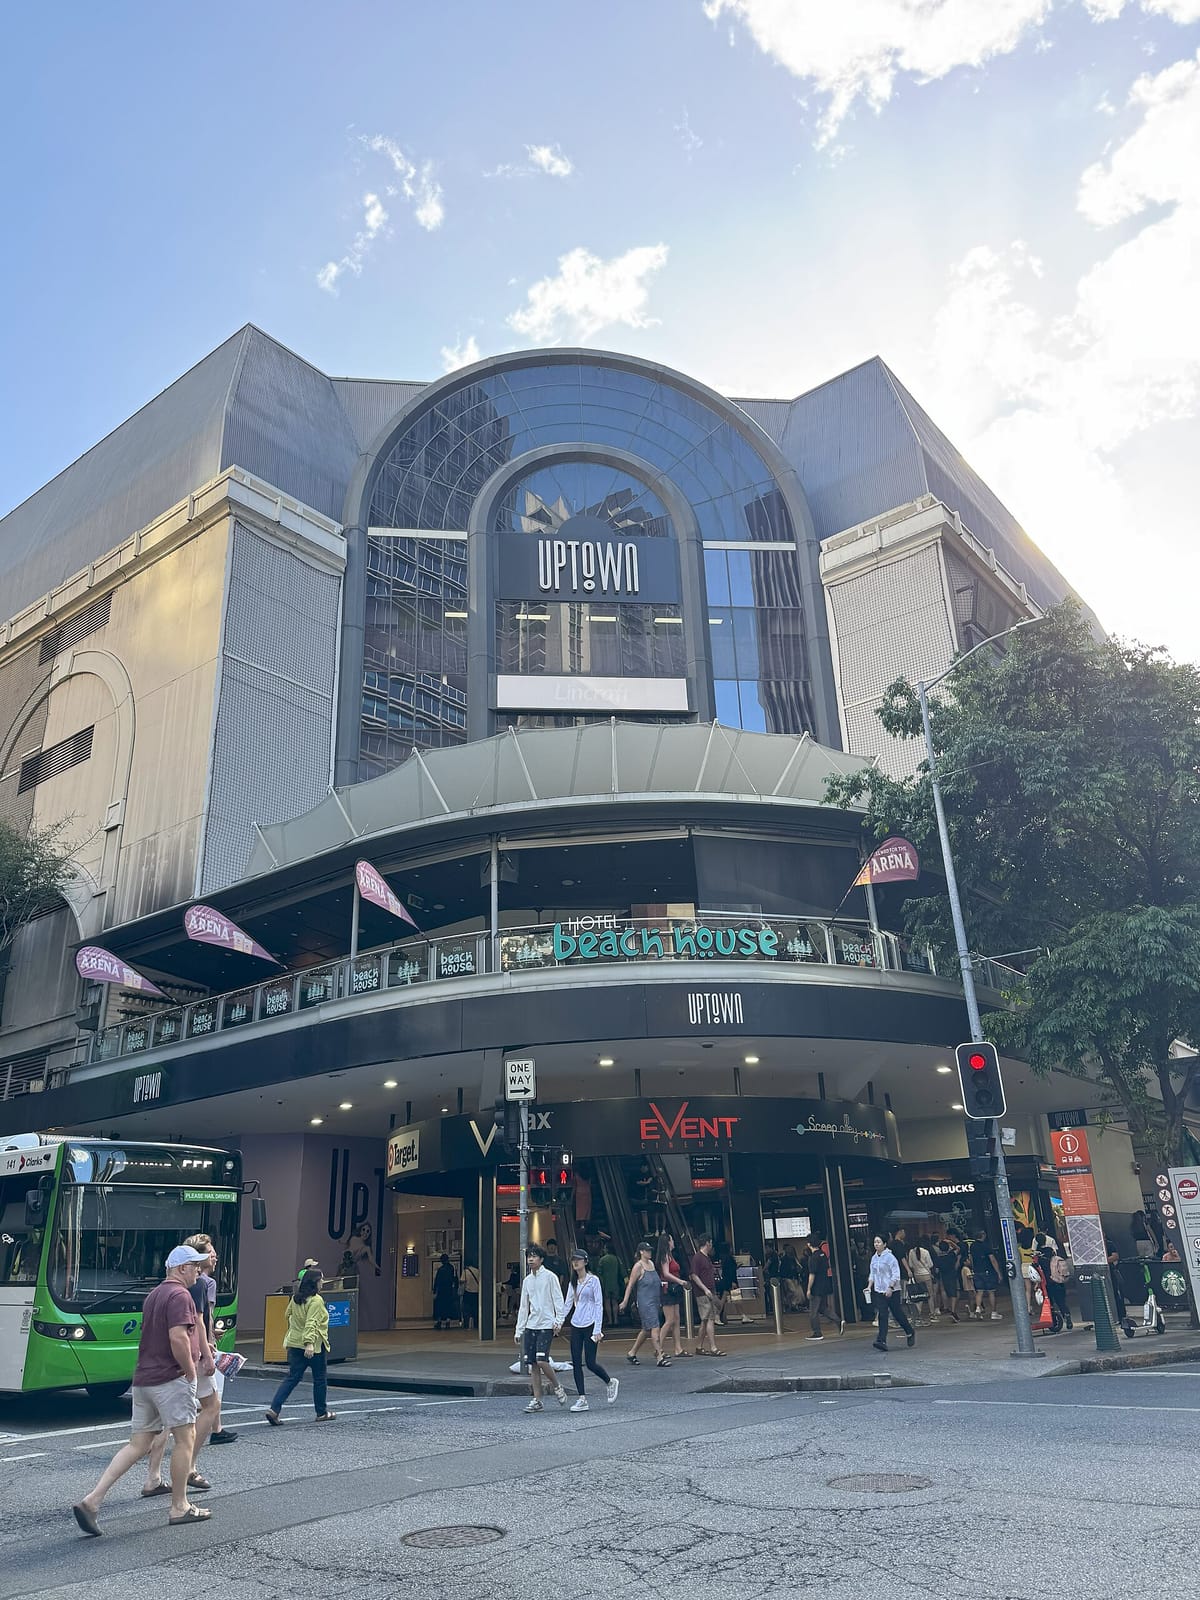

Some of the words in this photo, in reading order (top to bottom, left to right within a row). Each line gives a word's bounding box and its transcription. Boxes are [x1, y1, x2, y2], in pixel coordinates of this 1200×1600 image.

[538, 539, 640, 592] UPTOWN
[871, 852, 915, 876] ARENA
[188, 914, 229, 941] ARENA
[568, 914, 621, 931] HOTEL
[553, 922, 664, 961] beach
[674, 927, 778, 959] house
[841, 939, 873, 955] beach
[441, 951, 473, 965] beach
[843, 952, 873, 964] house
[80, 955, 120, 978] ARENA
[441, 961, 473, 975] house
[353, 968, 379, 983] beach
[353, 977, 378, 992] house
[688, 993, 744, 1024] UPTOWN
[510, 1063, 530, 1073] ONE
[133, 1071, 162, 1103] UPTOWN
[509, 1075, 531, 1085] WAY
[640, 1101, 738, 1140] EVENT
[641, 1140, 733, 1149] CINEMAS
[6, 1159, 16, 1170] 141
[26, 1157, 43, 1167] Clarks
[916, 1184, 976, 1196] STARBUCKS
